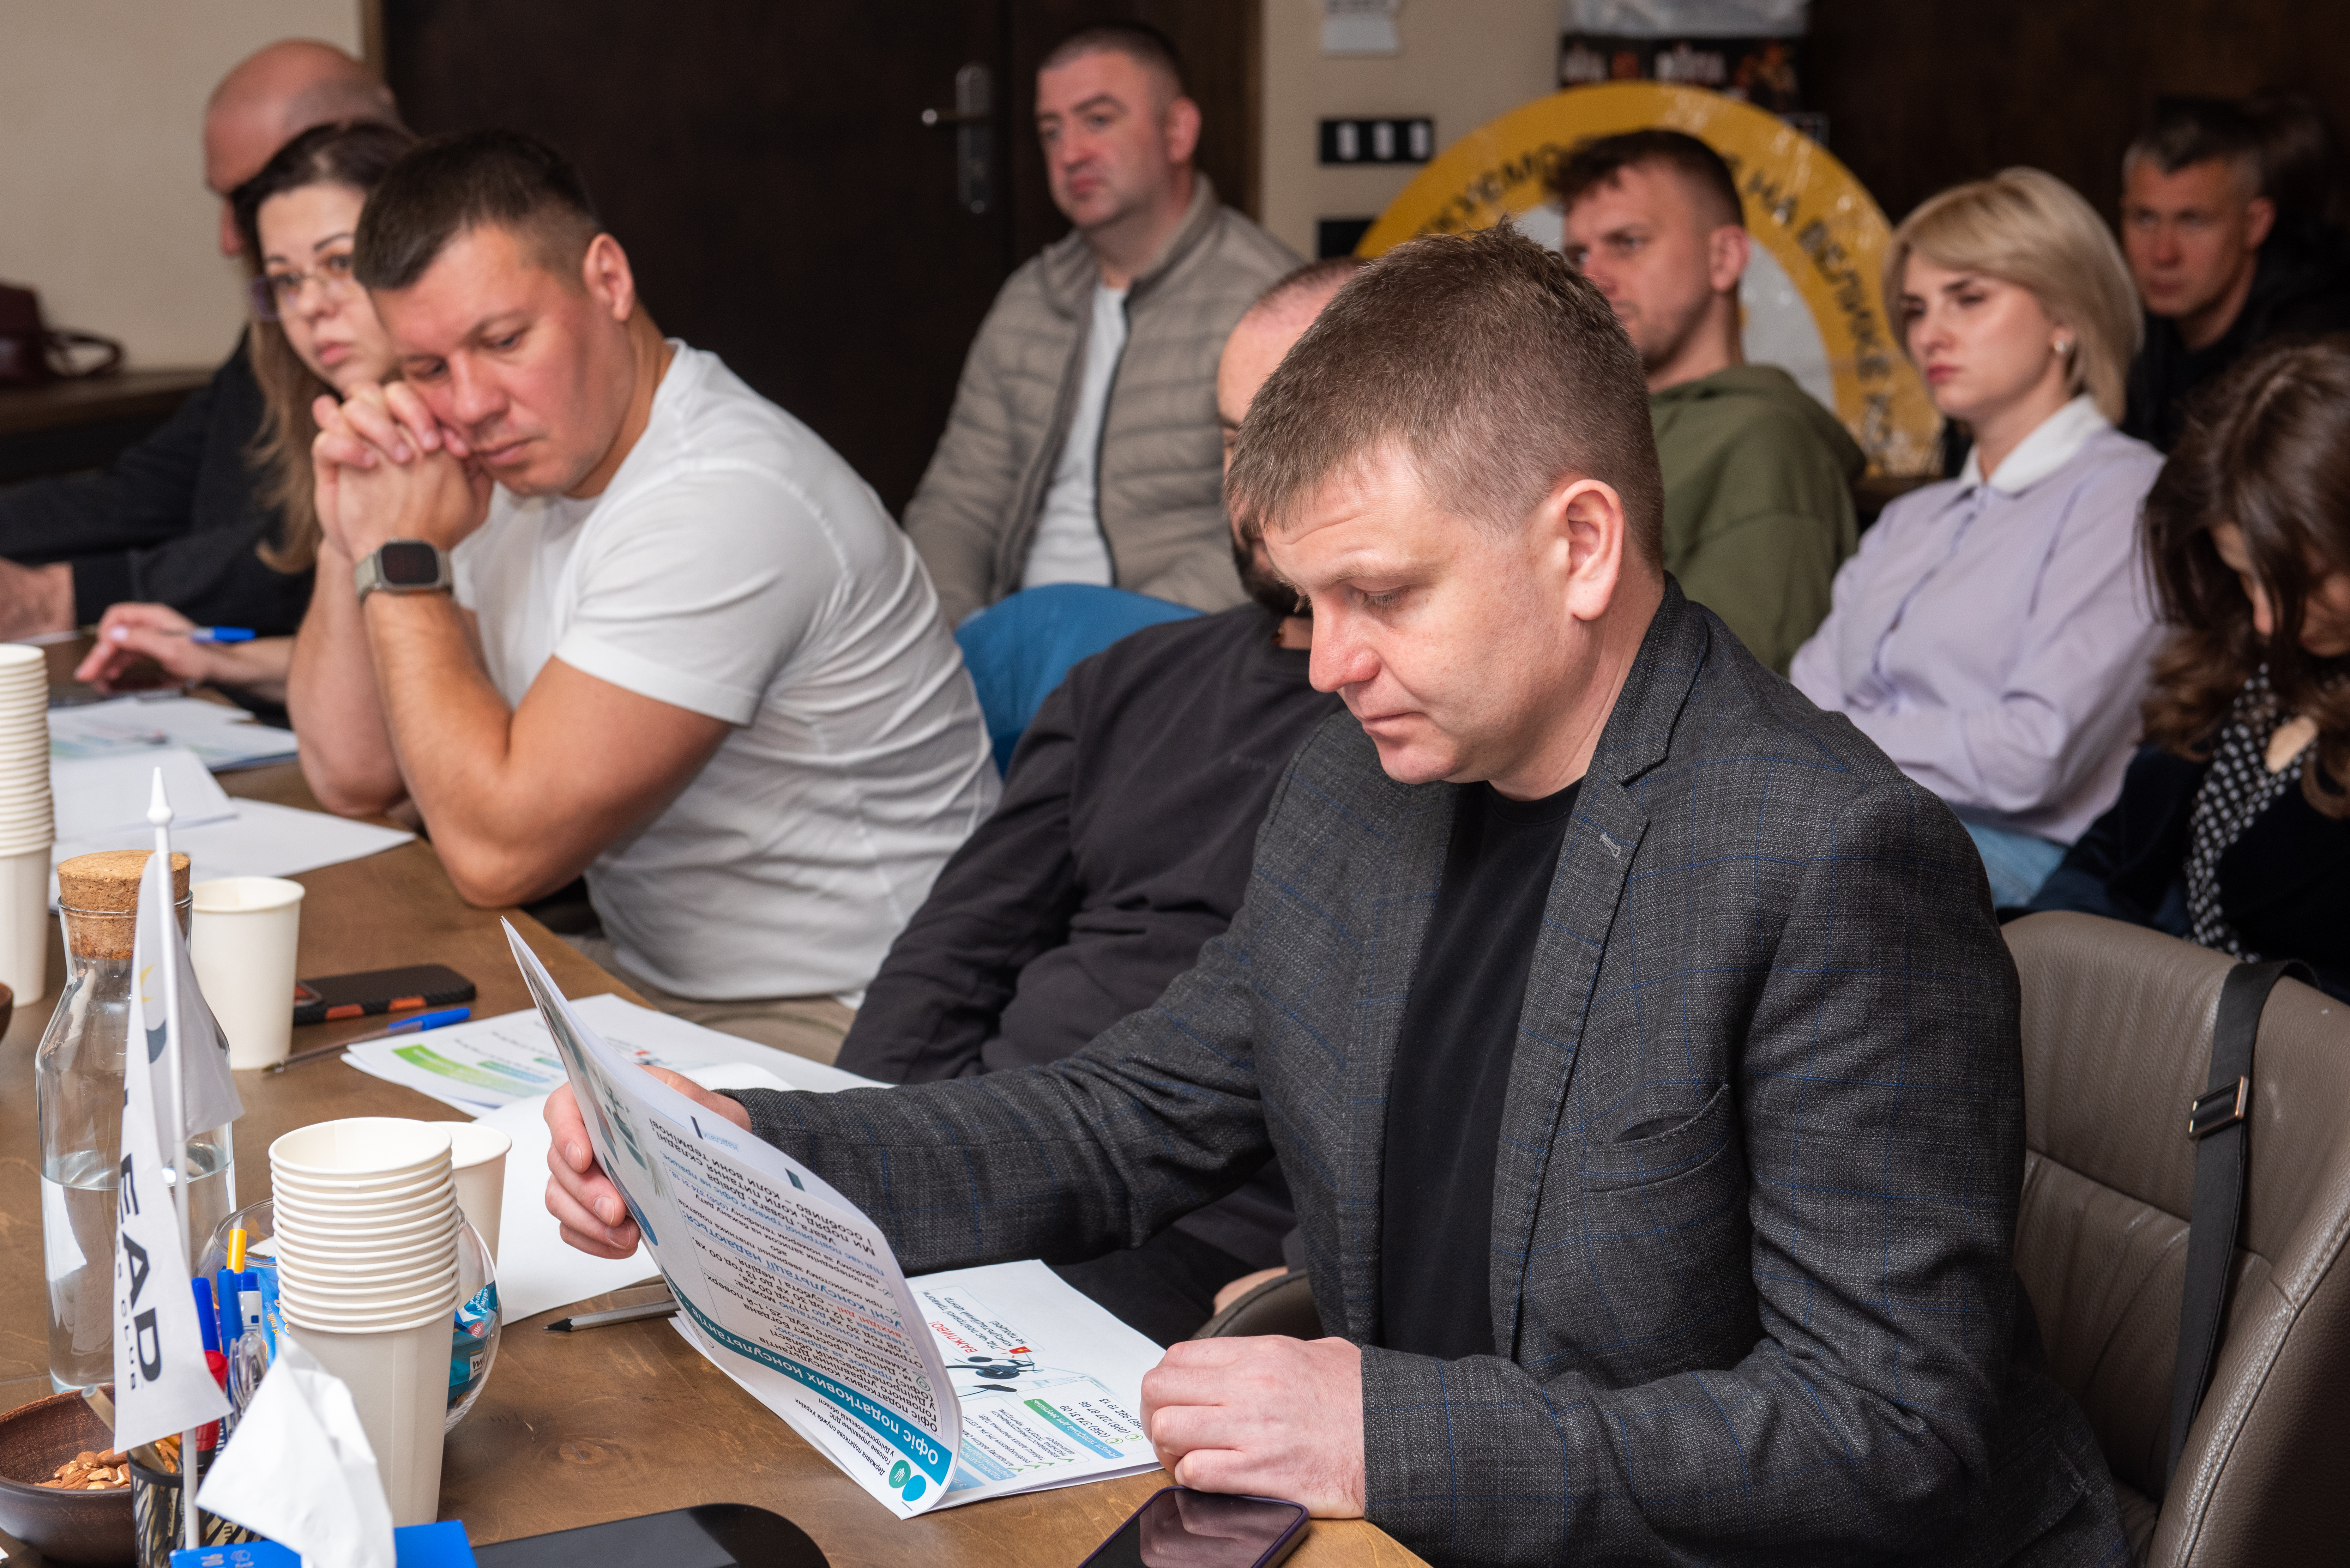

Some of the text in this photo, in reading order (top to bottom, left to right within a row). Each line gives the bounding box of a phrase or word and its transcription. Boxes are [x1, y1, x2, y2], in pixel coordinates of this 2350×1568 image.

[649, 1118, 709, 1161] термінові
[660, 1151, 697, 1180] працює.
[669, 1169, 680, 1180] 18.
[712, 1159, 743, 1180] вони
[652, 1127, 875, 1256] Ми поряд, коли питання складні,
[682, 1178, 689, 1187] 31
[691, 1185, 704, 1196] 374
[700, 1178, 711, 1188] не
[748, 1179, 780, 1199] коли
[695, 1194, 714, 1209] дату
[706, 1194, 728, 1211] (056)
[713, 1186, 739, 1204] Офіс
[706, 1173, 836, 1245] Увага. Повага. Довіра
[717, 1207, 749, 1229] бажану
[741, 1202, 783, 1227] тривоги
[731, 1208, 775, 1235] телефону
[796, 1204, 862, 1240] особливо
[751, 1227, 762, 1235] на
[785, 1225, 842, 1255] повітряної
[692, 1236, 707, 1251] хв,
[764, 1234, 804, 1255] записом
[770, 1245, 787, 1256] або
[778, 1233, 821, 1256] номером
[678, 1199, 882, 1309] при особистому зверненні платника податків
[709, 1249, 722, 1261] 00
[845, 1253, 863, 1265] час
[682, 1210, 904, 1330] Усні консультації надаються:
[724, 1258, 743, 1272] год
[735, 1257, 775, 1281] неділя.
[806, 1253, 863, 1283] попереднім
[837, 1260, 879, 1283] прийому
[739, 1273, 755, 1287] хв,
[746, 1270, 756, 1280] 13
[759, 1277, 773, 1288] до
[704, 1272, 743, 1300] поверх.
[758, 1284, 772, 1295] 00
[776, 1285, 789, 1295] хв
[785, 1282, 824, 1303] субота
[746, 1297, 763, 1310] 1-й
[774, 1291, 794, 1304] год
[793, 1293, 807, 1304] 30
[808, 1299, 829, 1313] год
[766, 1306, 782, 1319] 25,
[799, 1303, 809, 1312] 17
[812, 1309, 826, 1319] до
[832, 1310, 844, 1320] 12
[837, 1306, 855, 1318] дні
[267, 1312, 277, 1327] milk
[734, 1279, 923, 1369] Отримати консультацію можна:
[785, 1315, 809, 1333] буд.
[829, 1316, 843, 1326] хв
[858, 1316, 902, 1338] вихідні
[922, 1291, 1000, 1349] Під час повітряної тривоги
[944, 1297, 1014, 1346] консультаційний центр
[846, 1324, 861, 1335] 30
[856, 1321, 906, 1347] перерва
[862, 1330, 883, 1344] год
[928, 1321, 978, 1353] ВАЖЛИВО!
[989, 1321, 1018, 1338] працює!
[743, 1303, 912, 1382] м. Дніпро, проспект Богдана
[812, 1326, 908, 1374] Хмельницького,
[886, 1342, 901, 1352] 08
[770, 1329, 935, 1411] у Дніпропетровській області
[774, 1325, 933, 1402] (Офіс) працює за адресою:
[692, 1308, 938, 1465] Офіс податкових консультантів
[759, 1337, 937, 1432] Офіс податкових консультантів
[785, 1342, 936, 1422] Головного управління ДПС
[819, 1398, 839, 1414] області
[1031, 1398, 1059, 1418] звернень:
[1115, 1410, 1130, 1418] 982
[961, 1415, 978, 1426] ЄРПН;
[1077, 1417, 1092, 1426] 374
[1107, 1422, 1131, 1434] (098)
[795, 1398, 886, 1476] Державна податкова служба України
[829, 1412, 891, 1465] Головне управління ДПС
[840, 1412, 890, 1454] Дніпропетровській
[978, 1414, 1045, 1460] таблиці даних платника ПДВ;
[980, 1428, 997, 1440] ПН/РК
[991, 1410, 1060, 1458] відповідності/невідповідності
[998, 1409, 1068, 1456] платника податку критеріям
[1067, 1425, 1097, 1445] телефонів
[1087, 1426, 1111, 1437] (056)
[972, 1437, 992, 1449] роботи
[994, 1439, 1032, 1463] розблокування
[1045, 1436, 1077, 1455] ризиковості
[1095, 1444, 1120, 1460] Номери
[960, 1443, 1013, 1478] платникам податків
[989, 1449, 1014, 1466] алгоритму
[978, 1464, 1004, 1480] Надаємо
